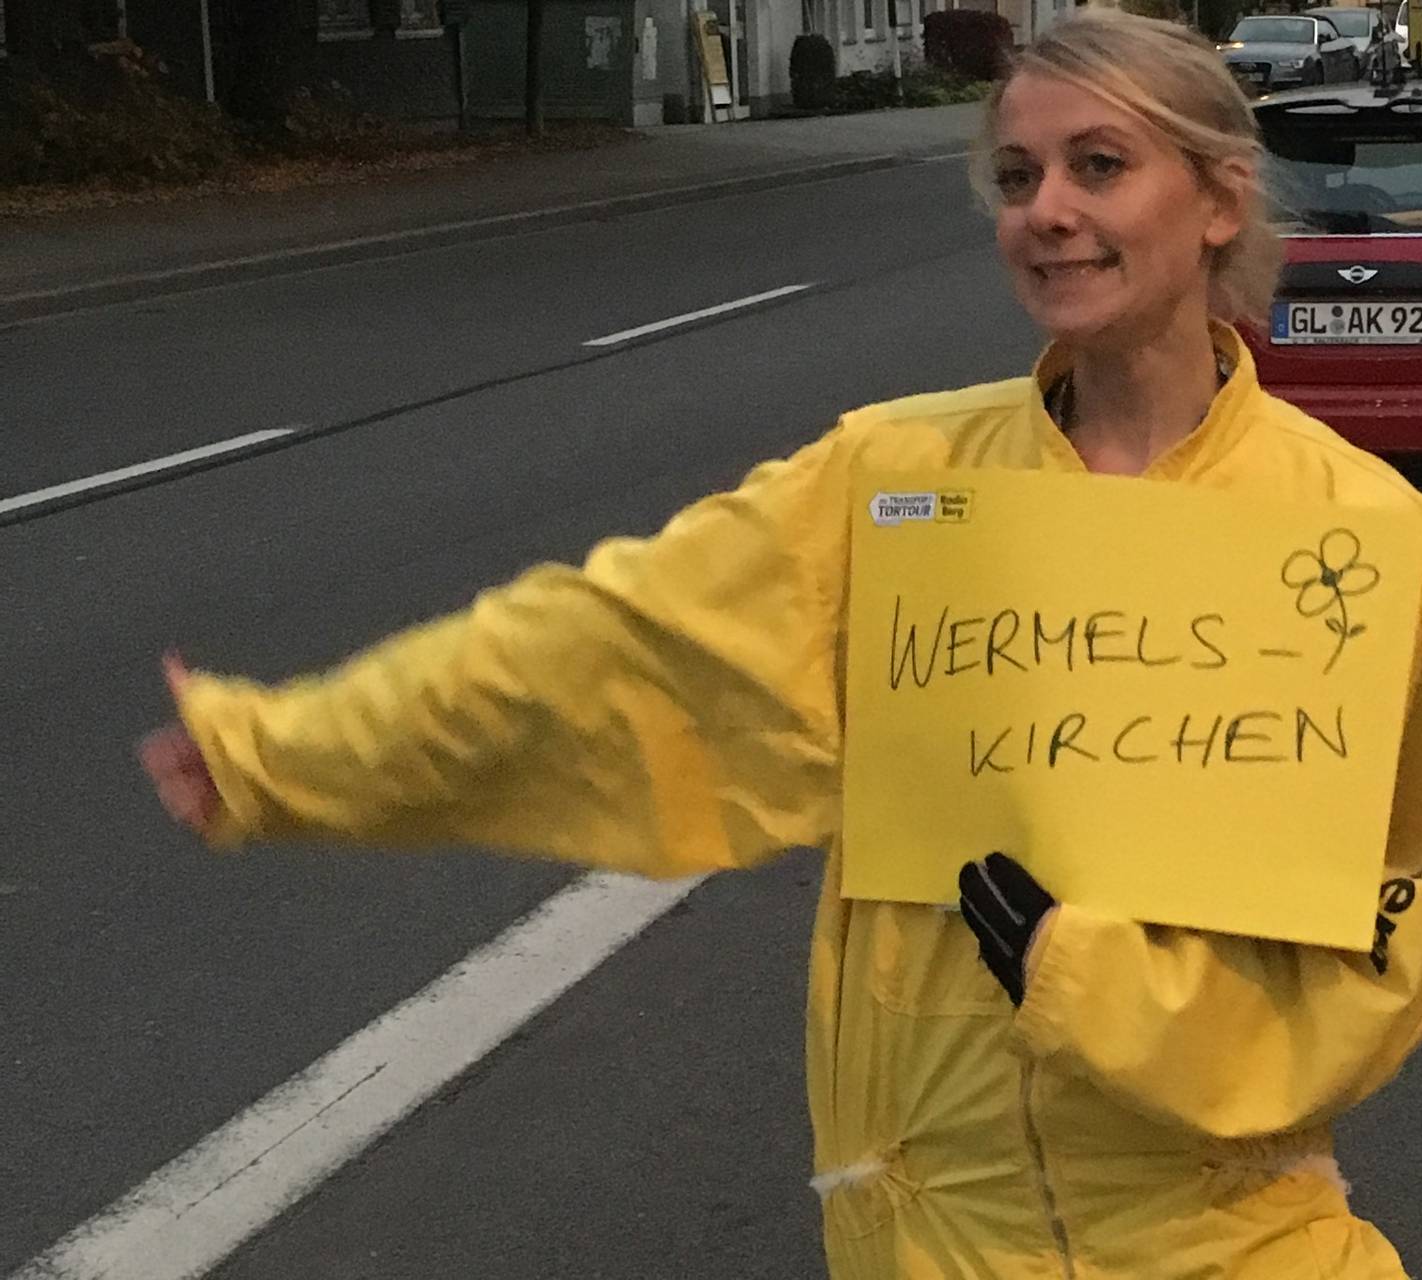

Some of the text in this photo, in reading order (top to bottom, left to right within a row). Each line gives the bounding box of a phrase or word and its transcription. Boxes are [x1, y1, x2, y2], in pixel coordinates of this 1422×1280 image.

[1291, 306, 1327, 334] GL
[1347, 306, 1384, 334] AK
[878, 504, 931, 517] TORTOUR
[969, 705, 1350, 777] KIRCHEN
